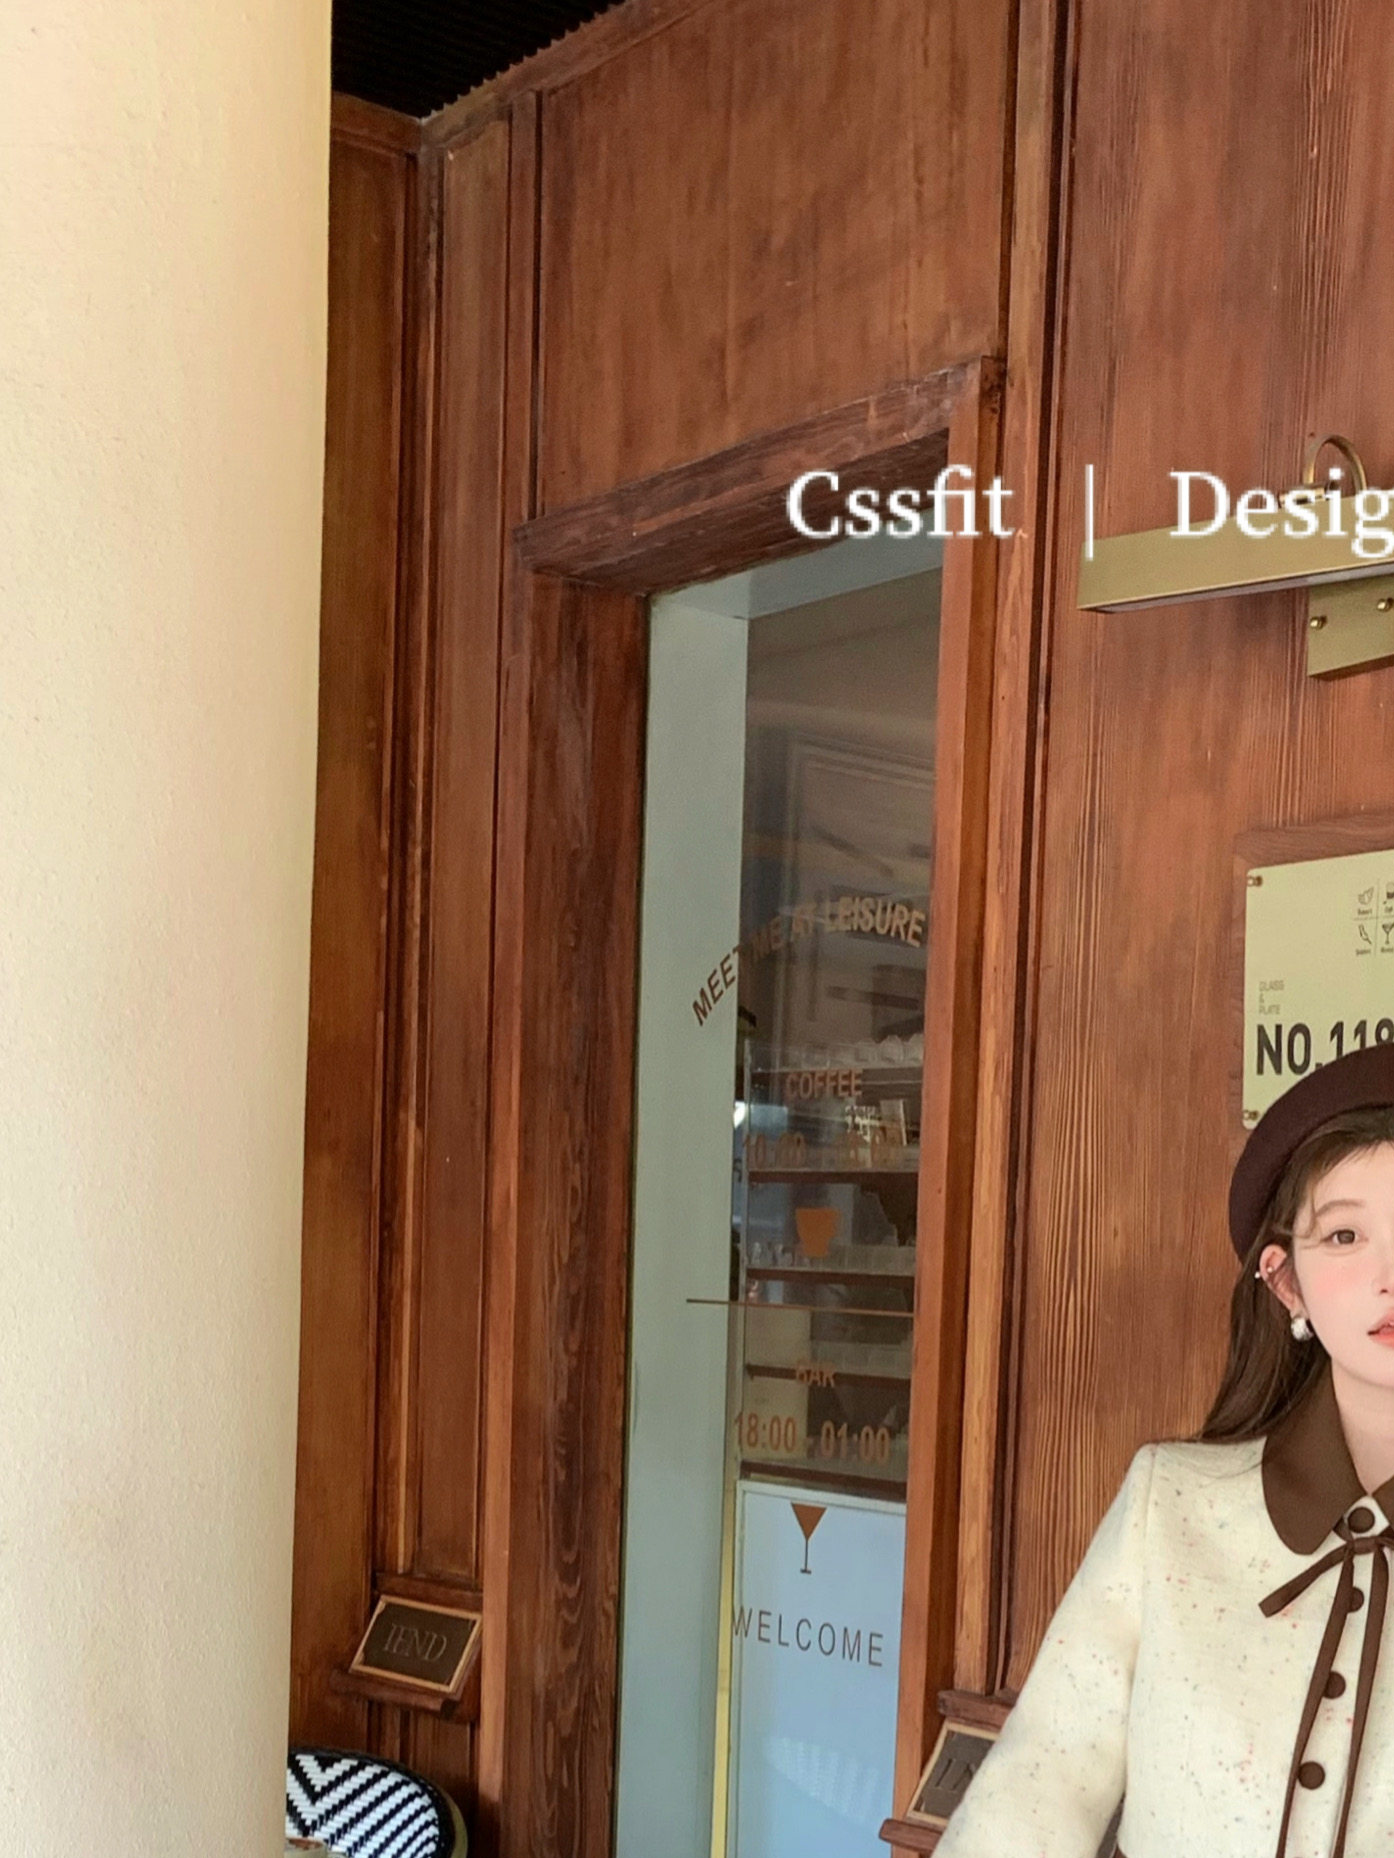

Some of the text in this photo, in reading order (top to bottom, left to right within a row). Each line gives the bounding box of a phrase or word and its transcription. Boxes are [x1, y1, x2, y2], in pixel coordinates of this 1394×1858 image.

[826, 896, 925, 948] LEISURE
[785, 1070, 863, 1098] COFFEE
[735, 1412, 797, 1452] 18:00
[821, 1420, 890, 1465] 01:00
[732, 1606, 884, 1667] WELCOME
